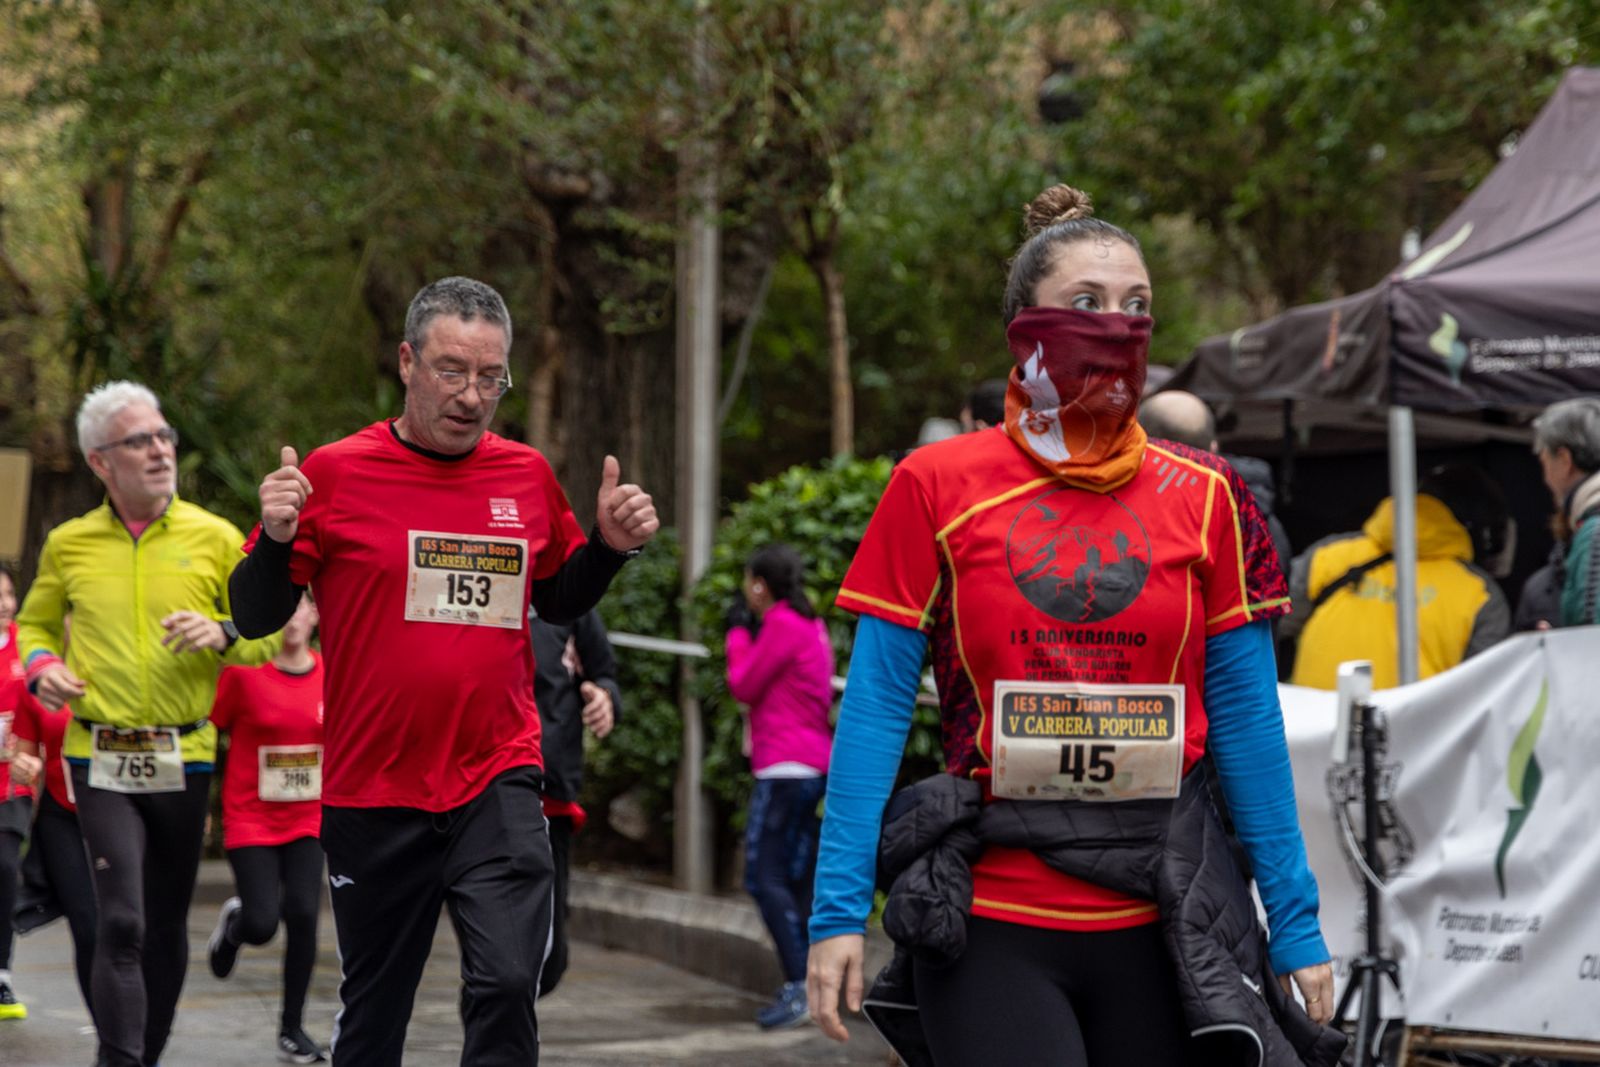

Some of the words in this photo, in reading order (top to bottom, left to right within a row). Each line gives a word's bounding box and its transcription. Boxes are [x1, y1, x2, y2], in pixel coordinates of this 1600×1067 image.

[421, 539, 437, 552] IES
[440, 541, 459, 553] San
[462, 542, 486, 555] Juan
[488, 543, 518, 557] Bosco
[418, 552, 427, 566] V
[429, 553, 473, 569] CARRERA
[477, 557, 519, 573] POPULAR
[446, 573, 491, 607] 153
[1036, 630, 1147, 647] ANIVERSARIO
[1055, 659, 1068, 668] DE
[1013, 696, 1037, 712] IES
[1042, 696, 1071, 713] San
[1075, 697, 1112, 713] Juan
[1117, 697, 1164, 714] Bosco
[1009, 715, 1020, 734] V
[1024, 715, 1094, 736] CARRERA
[1099, 717, 1168, 737] POPULAR
[117, 756, 156, 777] 765
[1059, 744, 1116, 783] 45
